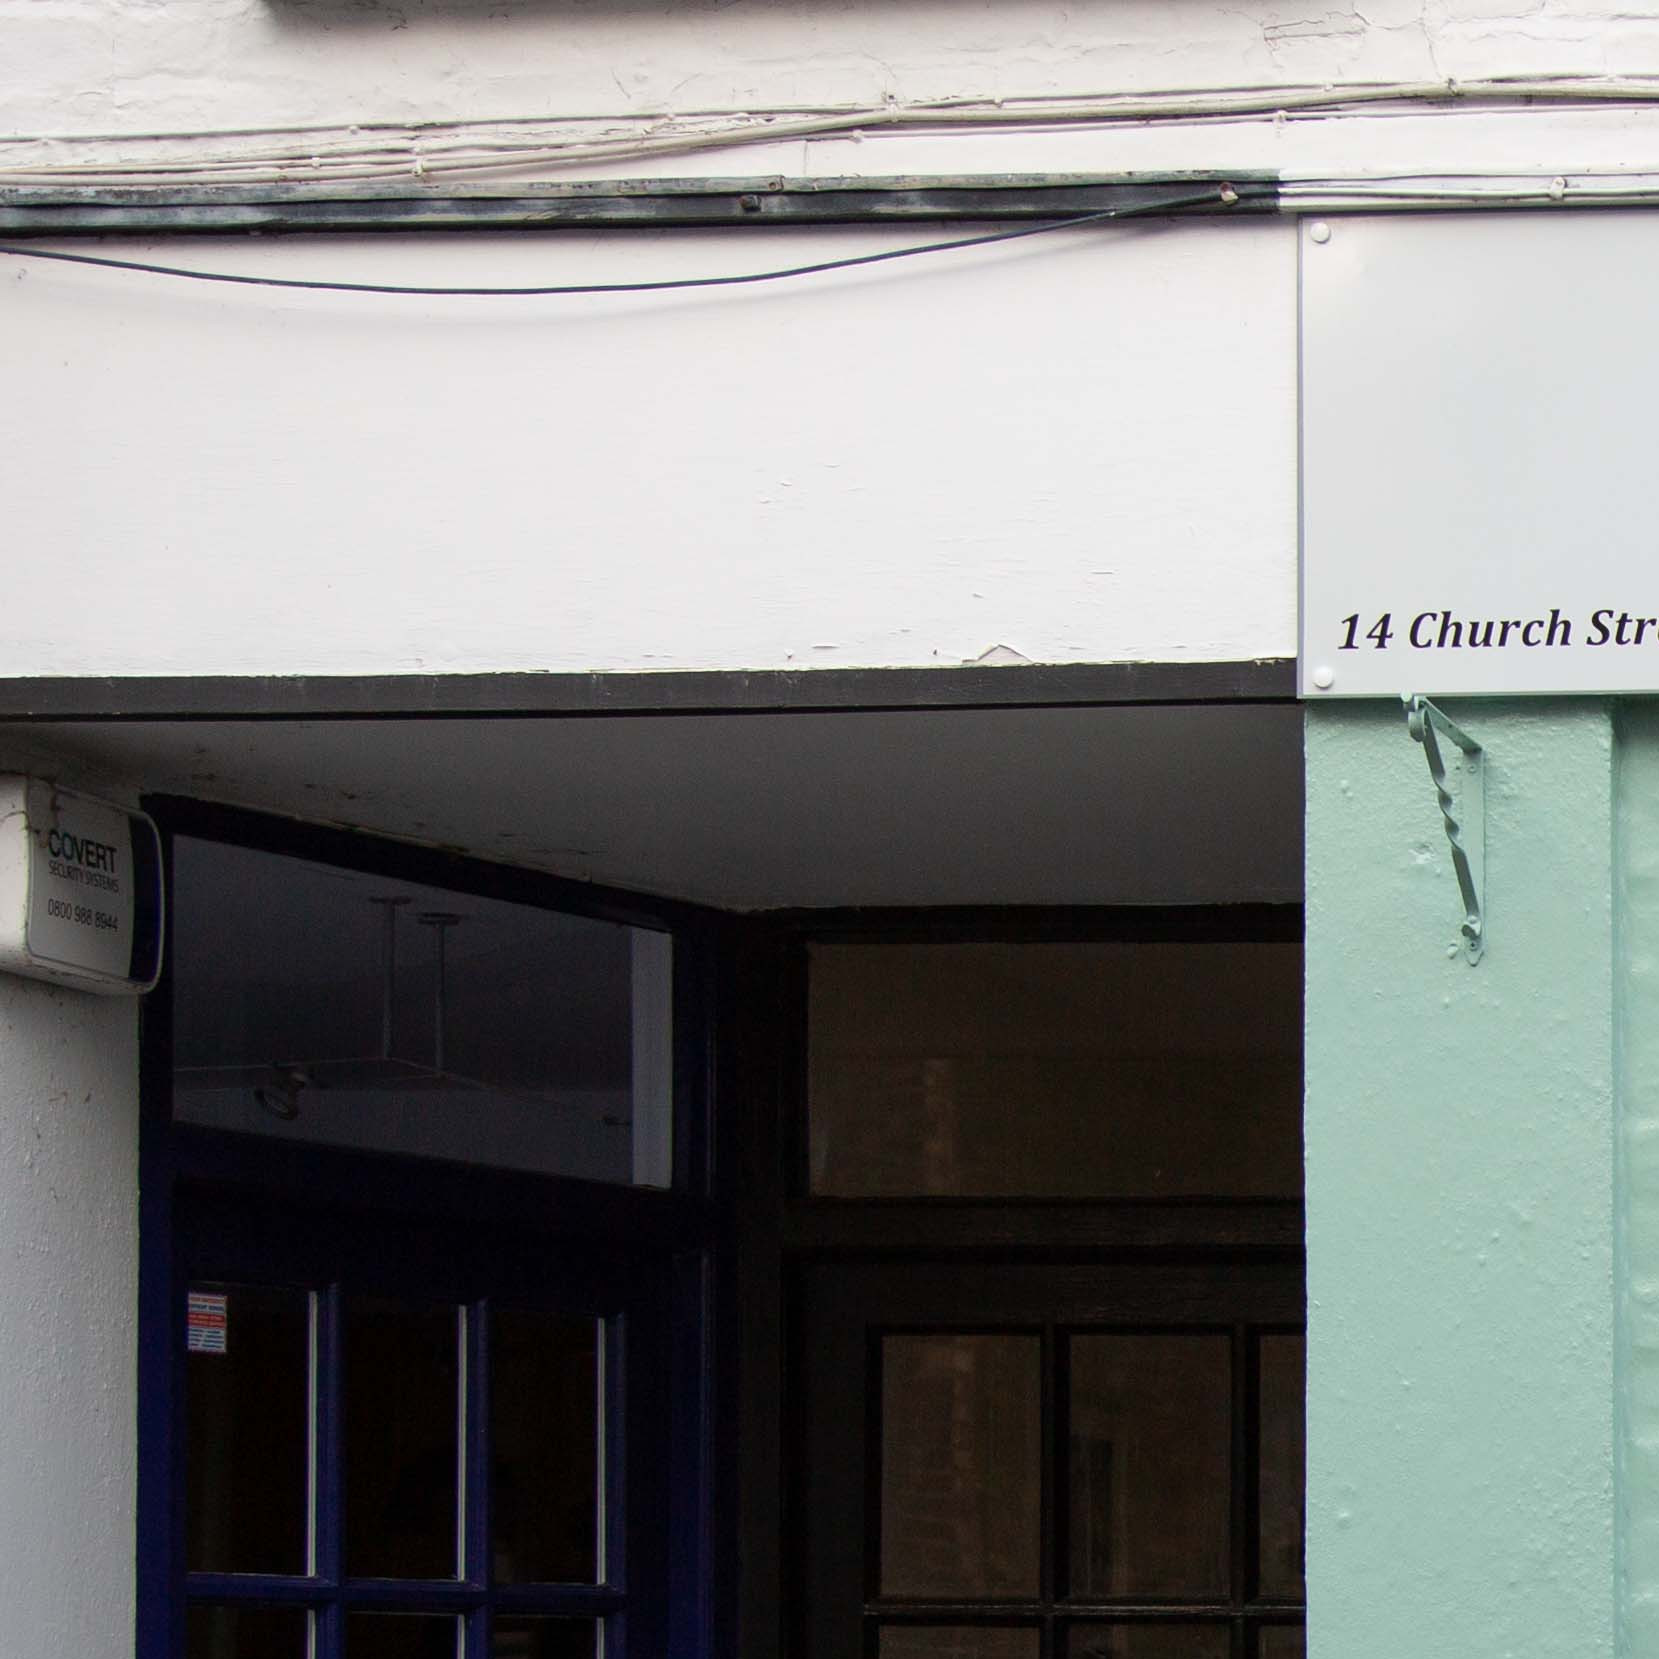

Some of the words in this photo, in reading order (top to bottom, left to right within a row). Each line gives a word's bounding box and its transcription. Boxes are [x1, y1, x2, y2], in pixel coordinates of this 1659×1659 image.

[1338, 612, 1394, 650] 14
[1409, 608, 1572, 649] Church
[48, 829, 118, 874] COVERT
[48, 862, 84, 884] SECURITY
[85, 869, 119, 893] SYSTEMS
[48, 898, 73, 921] 0800
